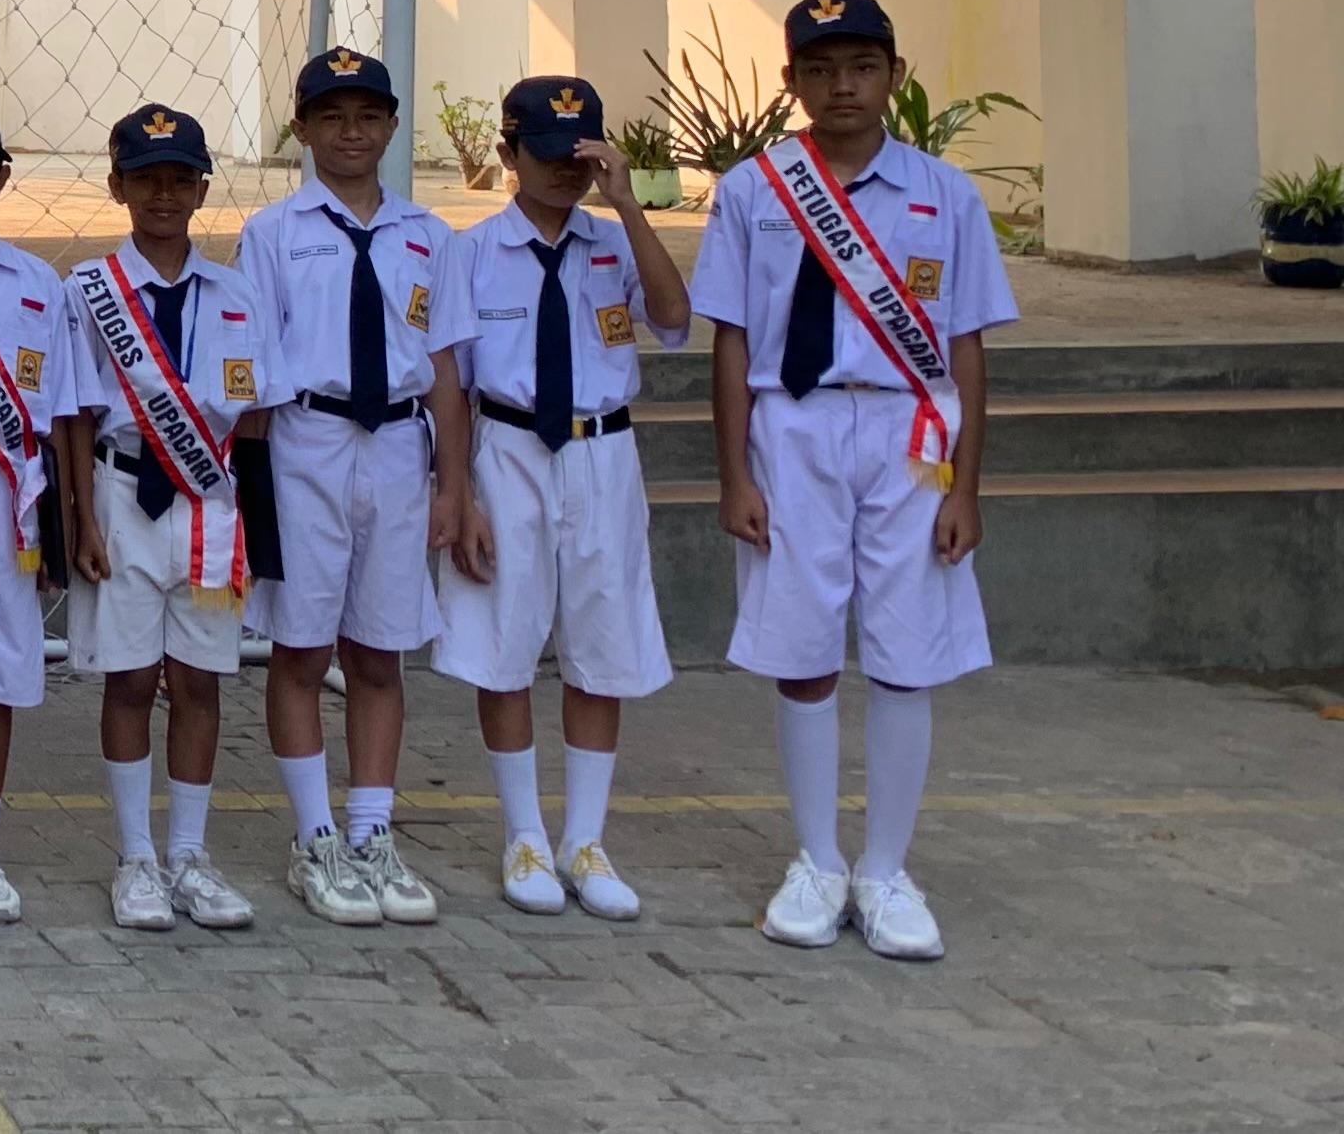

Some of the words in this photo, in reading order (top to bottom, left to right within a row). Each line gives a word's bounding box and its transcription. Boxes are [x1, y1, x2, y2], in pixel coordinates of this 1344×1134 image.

[77, 268, 143, 369] PETUGAS
[148, 392, 220, 491] UPACARA
[783, 160, 862, 261] PETUGAS
[868, 285, 945, 380] UPACARA
